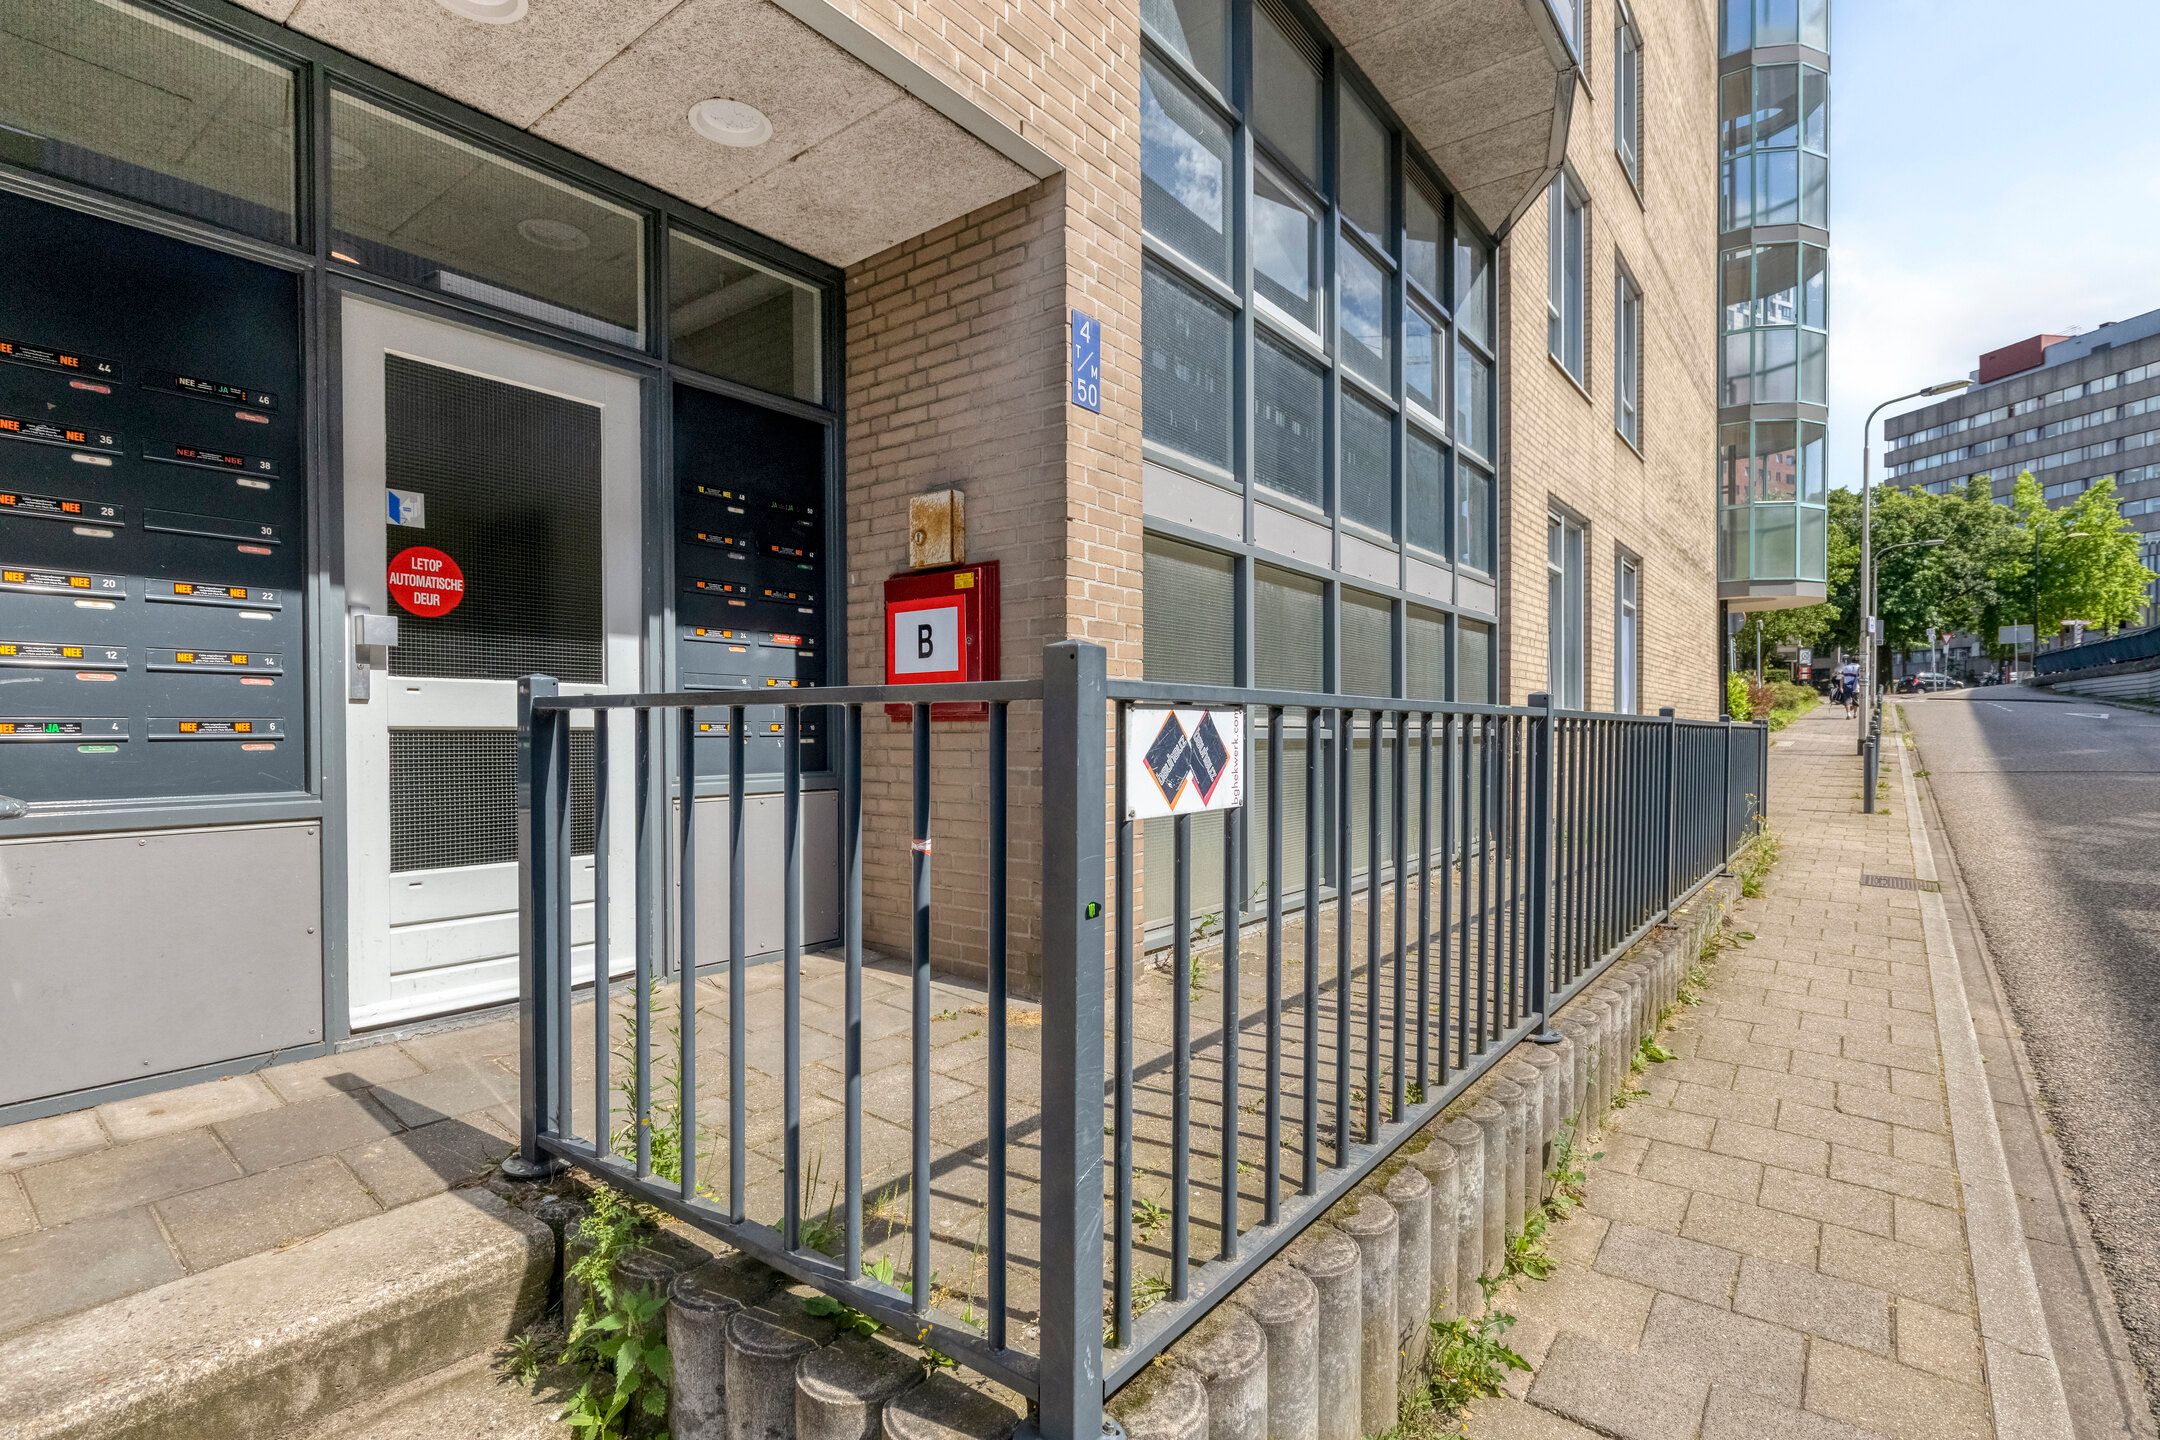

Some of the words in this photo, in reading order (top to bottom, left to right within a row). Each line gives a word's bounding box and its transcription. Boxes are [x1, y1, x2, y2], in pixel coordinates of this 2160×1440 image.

[1080, 321, 1091, 343] 4
[0, 342, 12, 353] EE
[60, 355, 79, 367] NEE
[98, 363, 111, 372] 44
[179, 378, 196, 387] NEE
[218, 386, 228, 394] JA
[1077, 378, 1097, 407] 50
[258, 396, 270, 404] 46
[0, 419, 20, 431] NEE
[66, 430, 85, 442] NEE
[100, 435, 113, 444] 36
[176, 448, 196, 458] NEE
[260, 461, 271, 470] 38
[62, 502, 81, 513] NEE
[101, 507, 114, 516] 28
[261, 526, 272, 535] 30
[411, 557, 443, 572] LETOP
[4, 572, 25, 582] NEE
[70, 577, 90, 588] NEE
[102, 580, 116, 588] 20
[390, 572, 463, 591] AUTOMATISCHE
[175, 584, 192, 594] NEE
[230, 588, 246, 598] NEE
[262, 592, 274, 600] 22
[414, 592, 440, 607] DEUR
[918, 624, 933, 659] B
[63, 648, 82, 658] NEE
[106, 651, 118, 660] 12
[176, 653, 194, 663] NEE
[232, 655, 247, 665] NEE
[264, 658, 274, 666] 14
[46, 724, 60, 733] JA
[112, 722, 118, 730] 4
[180, 723, 198, 732] NEE
[234, 722, 250, 732] NEE
[270, 722, 276, 730] 6
[1231, 708, 1241, 806] bghekwerk.com
